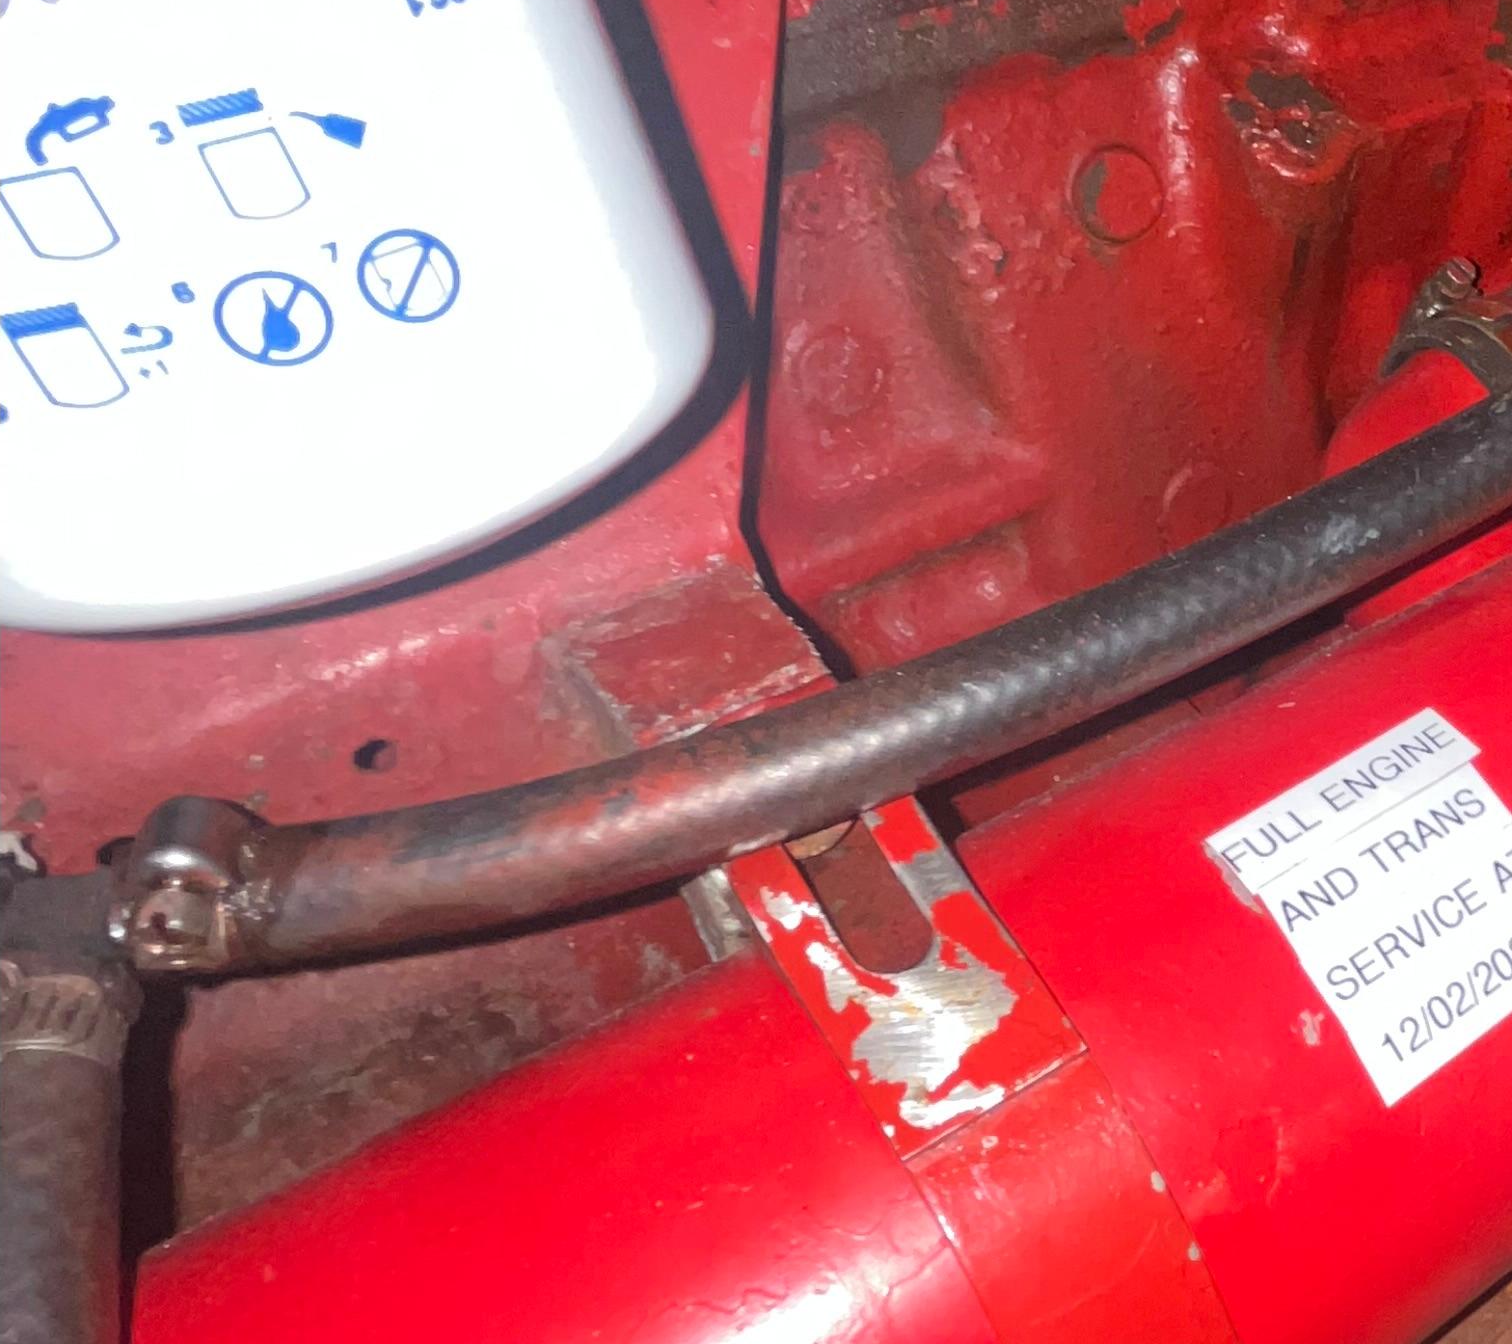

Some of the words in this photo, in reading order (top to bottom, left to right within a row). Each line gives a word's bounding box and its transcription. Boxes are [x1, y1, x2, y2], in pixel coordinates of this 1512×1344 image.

[1220, 810, 1322, 875] FULL
[1320, 721, 1456, 813] ENGINE
[1278, 866, 1360, 932] AND
[1360, 786, 1487, 874] TRANS
[1326, 879, 1489, 1002] SERVICE
